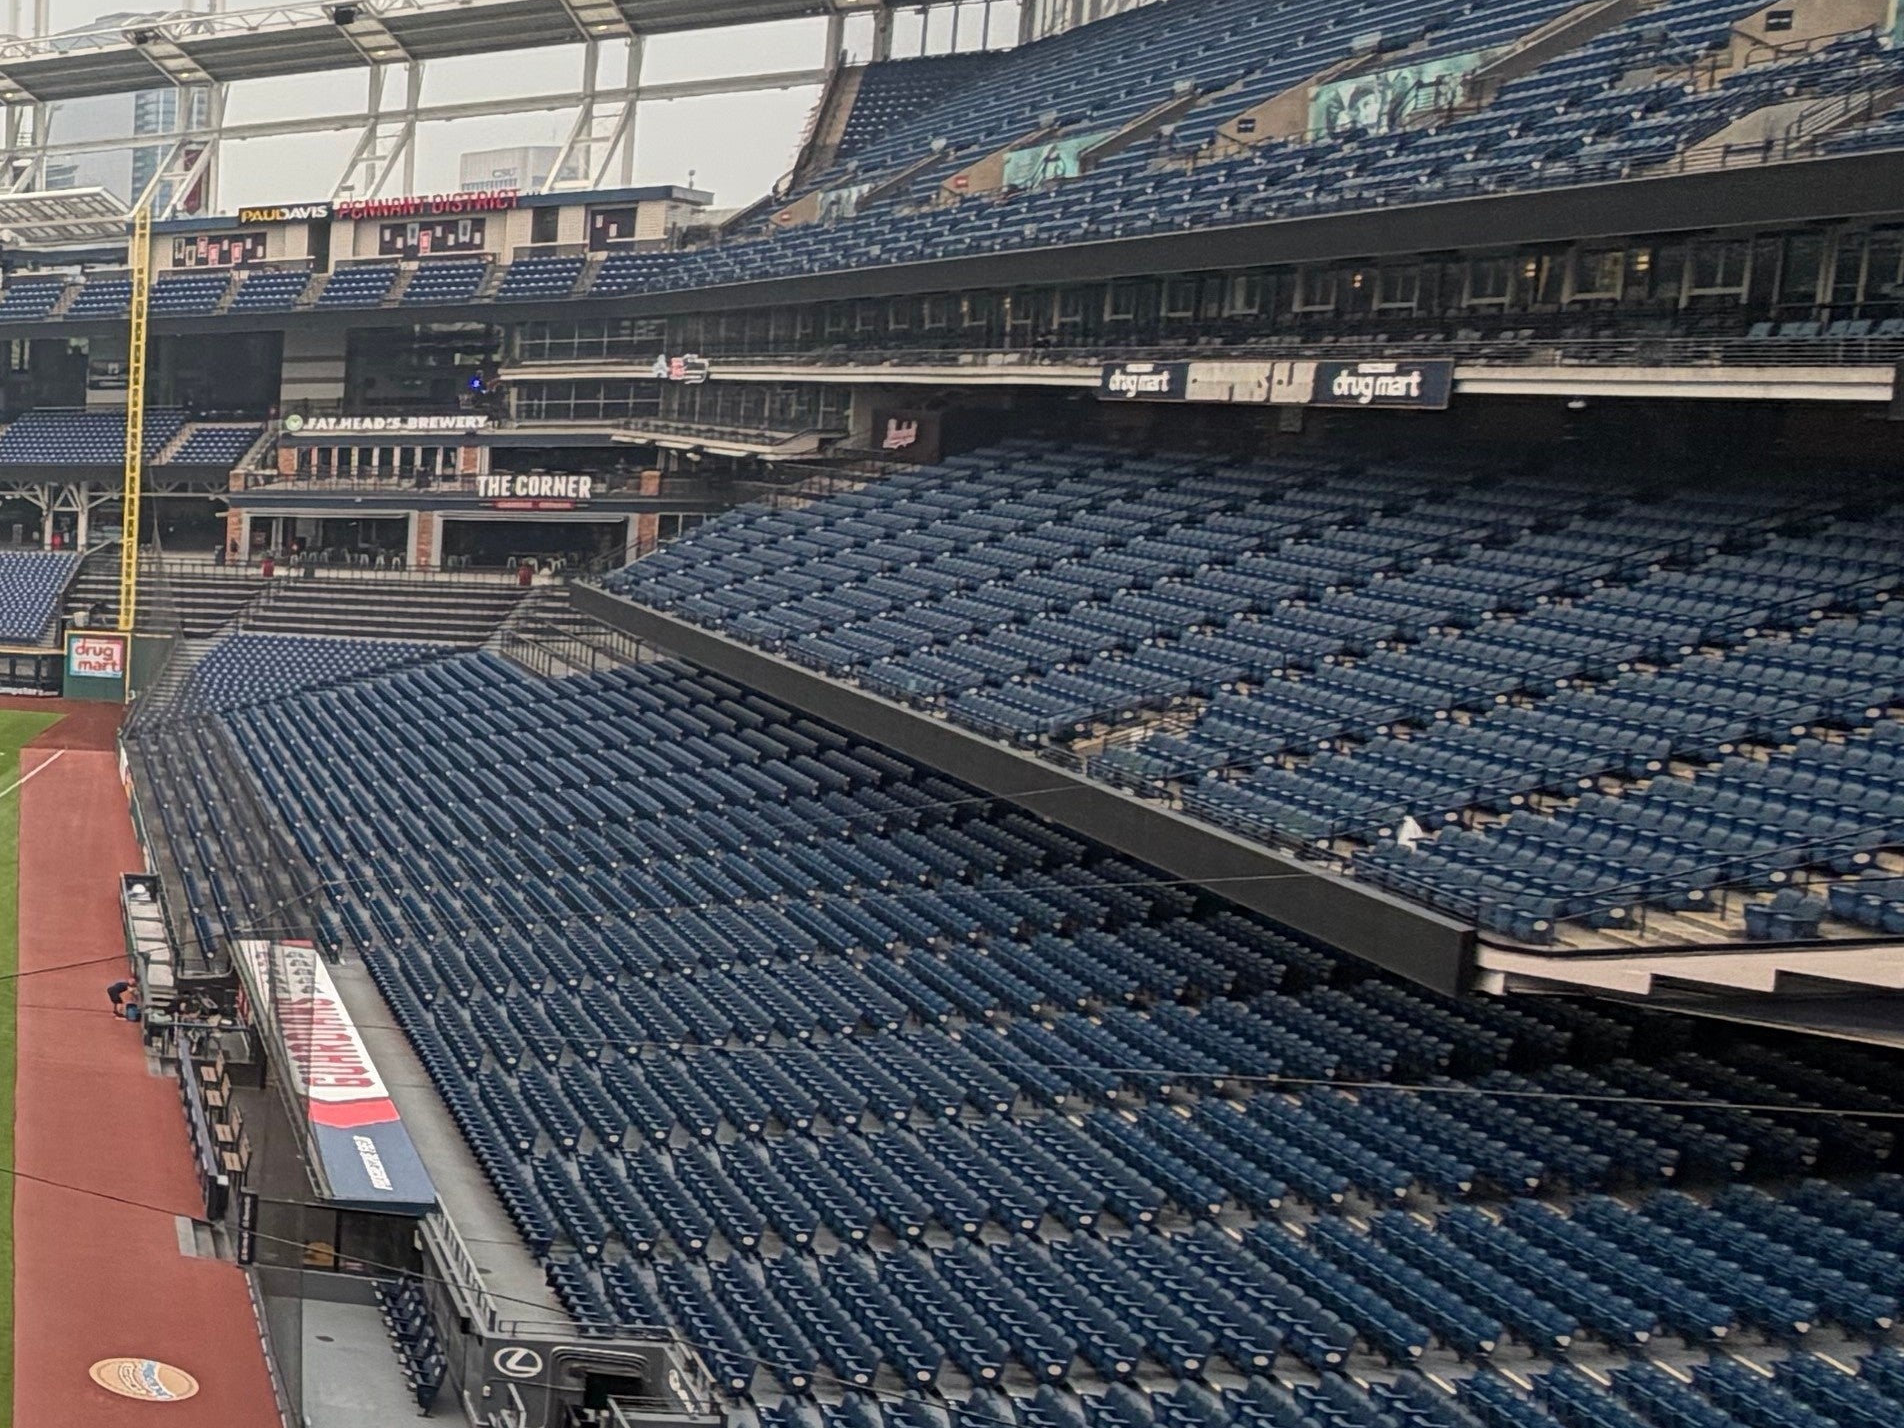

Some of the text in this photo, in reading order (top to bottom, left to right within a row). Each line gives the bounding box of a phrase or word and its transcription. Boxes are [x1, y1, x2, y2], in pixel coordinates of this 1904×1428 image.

[241, 205, 329, 223] PAUL DAVIS
[339, 189, 521, 220] PENNANT DISTRICT
[1332, 369, 1421, 404] drug mart
[407, 415, 489, 430] BREWERY
[476, 474, 592, 499] THE CORNER
[75, 638, 114, 661] drug
[78, 660, 119, 671] mart
